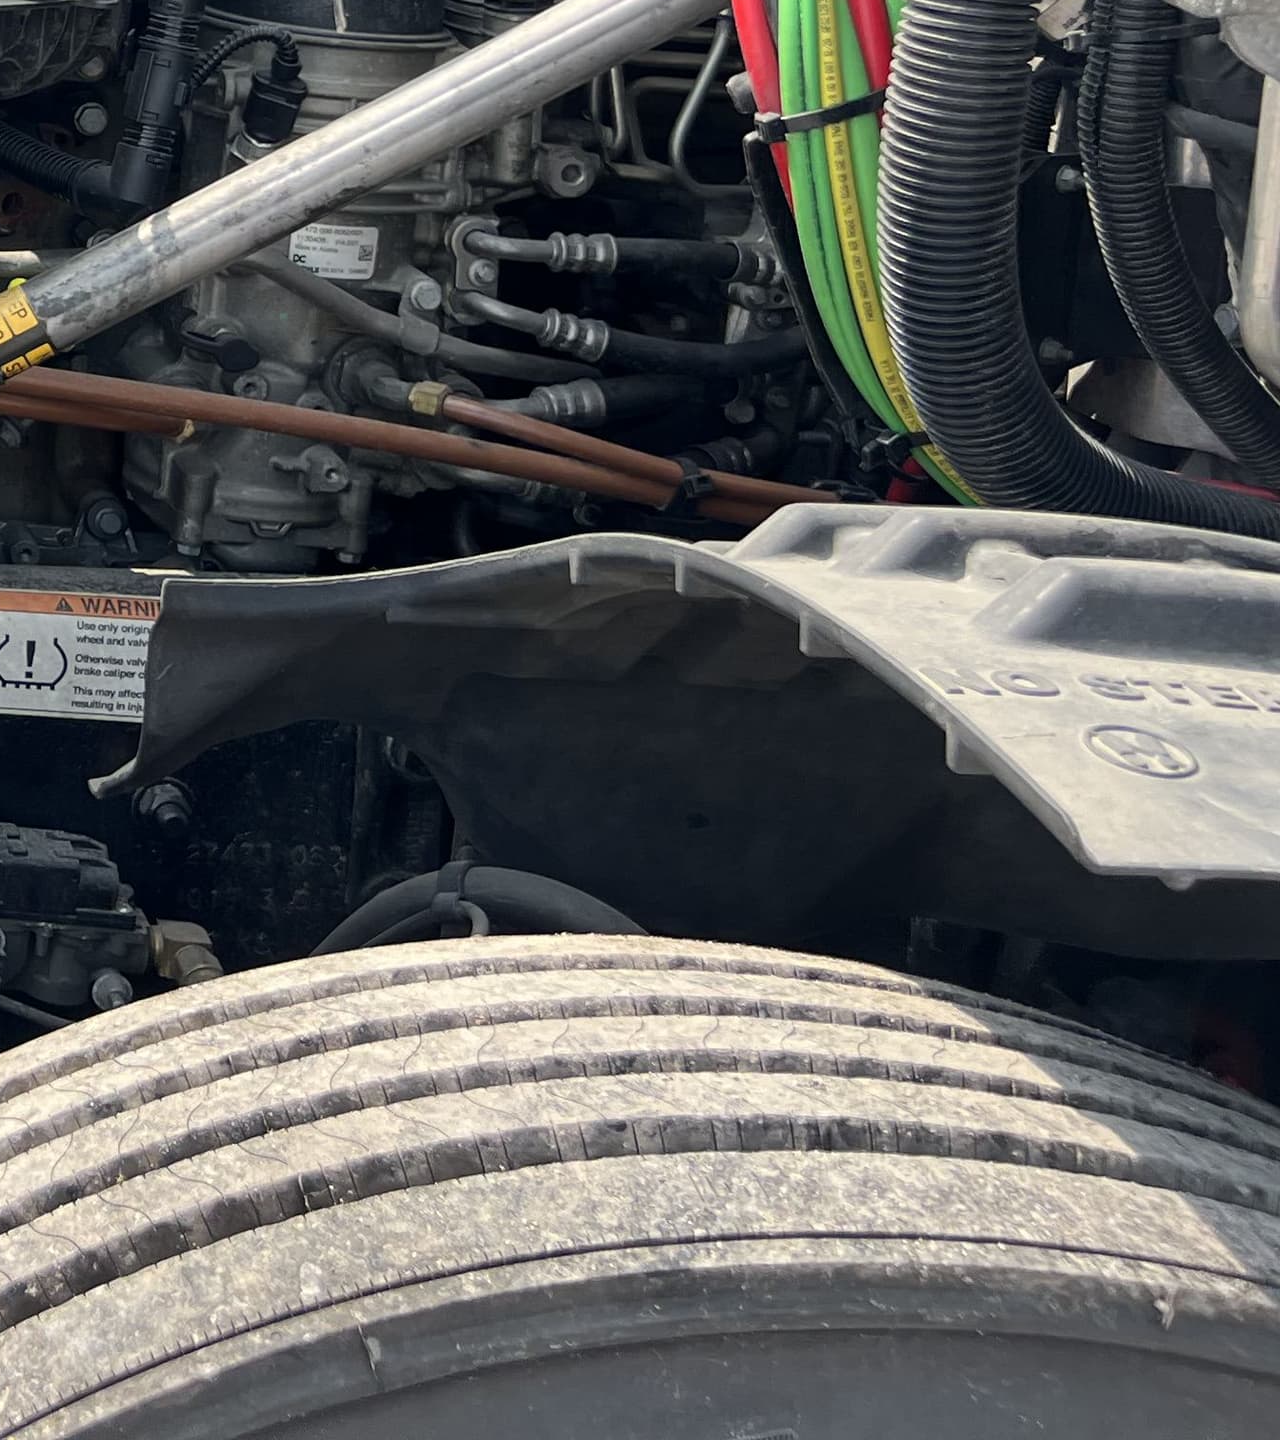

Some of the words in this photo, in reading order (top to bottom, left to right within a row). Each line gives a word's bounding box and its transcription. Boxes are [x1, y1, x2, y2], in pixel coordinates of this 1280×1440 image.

[293, 254, 307, 264] DC
[77, 621, 96, 631] Use
[98, 622, 119, 634] only
[121, 624, 152, 636] origin
[76, 635, 104, 645] wheel
[106, 637, 125, 647] and
[127, 638, 148, 648] valv
[75, 654, 124, 666] Otherwise
[74, 666, 102, 677] brake
[103, 668, 136, 680] caliper
[918, 666, 1061, 697] NO
[73, 686, 93, 696] This
[95, 688, 116, 699] may
[71, 700, 114, 712] resulting
[116, 701, 125, 711] in
